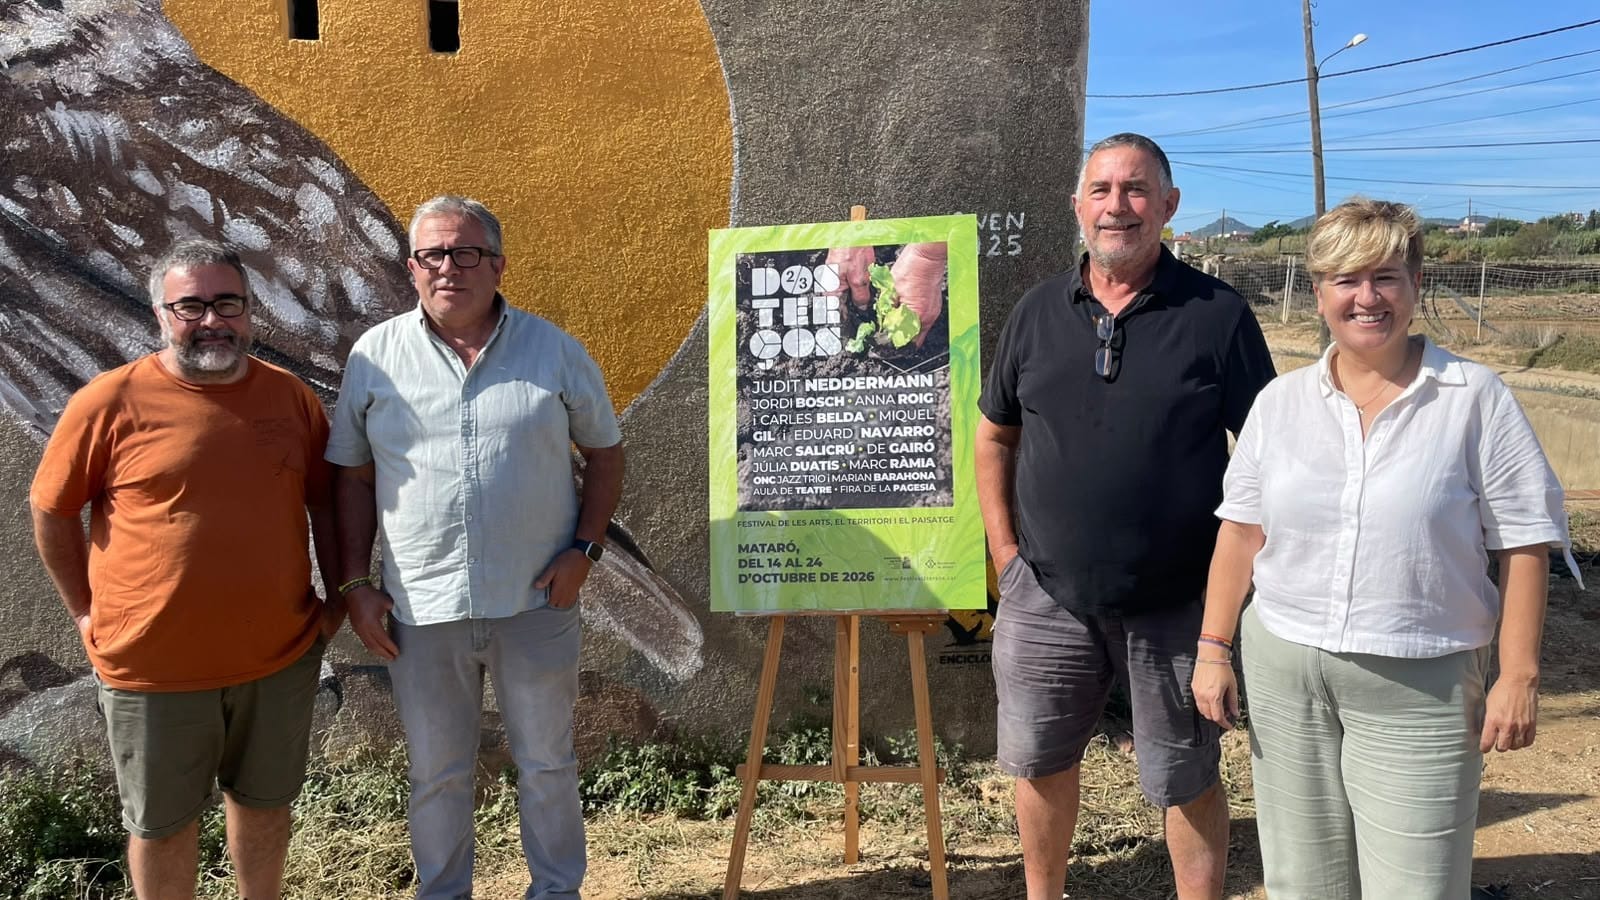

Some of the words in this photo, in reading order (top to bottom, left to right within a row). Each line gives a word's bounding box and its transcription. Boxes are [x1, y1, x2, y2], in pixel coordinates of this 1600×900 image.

[954, 211, 1025, 231] VEN
[977, 234, 1022, 256] 25
[751, 263, 840, 296] DOS
[752, 379, 800, 394] JUDIT
[805, 374, 933, 392] NEDDERMANN
[752, 398, 793, 410] JORDI
[795, 396, 845, 408] BOSCH
[855, 394, 896, 406] ANNA
[898, 393, 934, 404] ROIG
[760, 413, 813, 426] CARLES
[816, 412, 865, 424] BELDA
[879, 409, 934, 423] MIQUEL
[752, 431, 776, 442] GIL
[794, 428, 853, 440] EDUARD
[861, 425, 935, 438] NAVARRO
[753, 446, 793, 458] MARC
[795, 442, 855, 457] SALICRÚ
[867, 443, 886, 454] DE
[889, 439, 935, 453] GAIRÓ
[752, 461, 788, 473] JÚLIA
[790, 460, 840, 472] DUATIS
[849, 459, 888, 470] MARC
[889, 456, 936, 469] RÀMIA
[753, 476, 776, 485] ONC
[776, 475, 801, 484] JAZZ
[802, 474, 826, 483] TRIO
[832, 473, 872, 482] MARIAN
[873, 471, 936, 482] BARAHONA
[753, 487, 778, 496] AULA
[780, 487, 793, 495] DE
[795, 486, 832, 494] TEATRE
[840, 485, 862, 493] FIRA
[863, 485, 877, 493] DE
[879, 484, 891, 492] LA
[893, 483, 936, 492] PAGESIA
[737, 520, 776, 528] FESTIVAL
[791, 519, 807, 527] LES
[809, 519, 833, 527] ARTS,
[848, 518, 892, 526] TERRITORI
[899, 517, 910, 525] EL
[912, 516, 955, 524] PAISATGE
[737, 539, 800, 554] MATARÓ,
[738, 558, 765, 569] DEL
[767, 558, 782, 568] 14
[784, 557, 803, 568] AL
[806, 556, 823, 568] 24
[738, 573, 817, 584] D'OCTUBRE
[820, 572, 839, 583] DE
[842, 571, 875, 582] 2026
